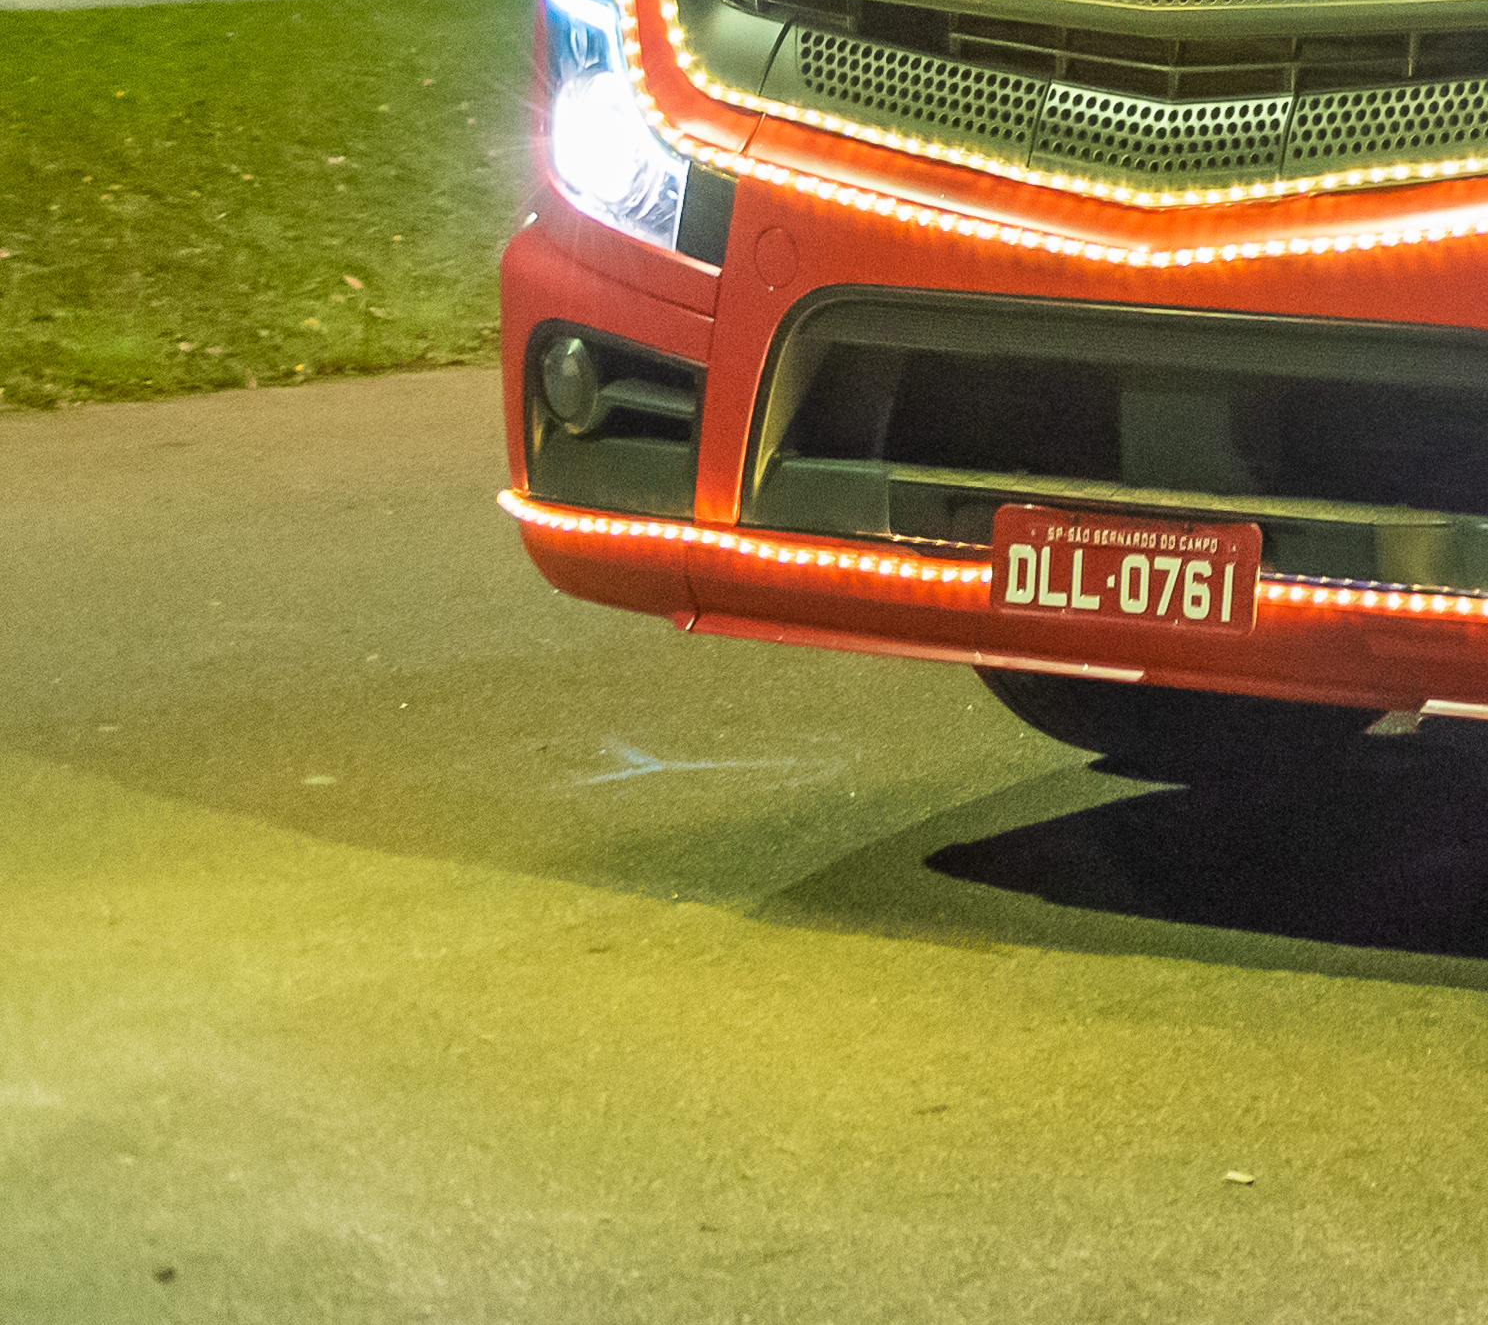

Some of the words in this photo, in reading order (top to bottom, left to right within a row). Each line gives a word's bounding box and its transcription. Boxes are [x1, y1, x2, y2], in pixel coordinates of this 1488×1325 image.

[1093, 529, 1157, 549] BERNARDO
[1160, 533, 1176, 551] DO
[1179, 536, 1219, 554] CAMPO
